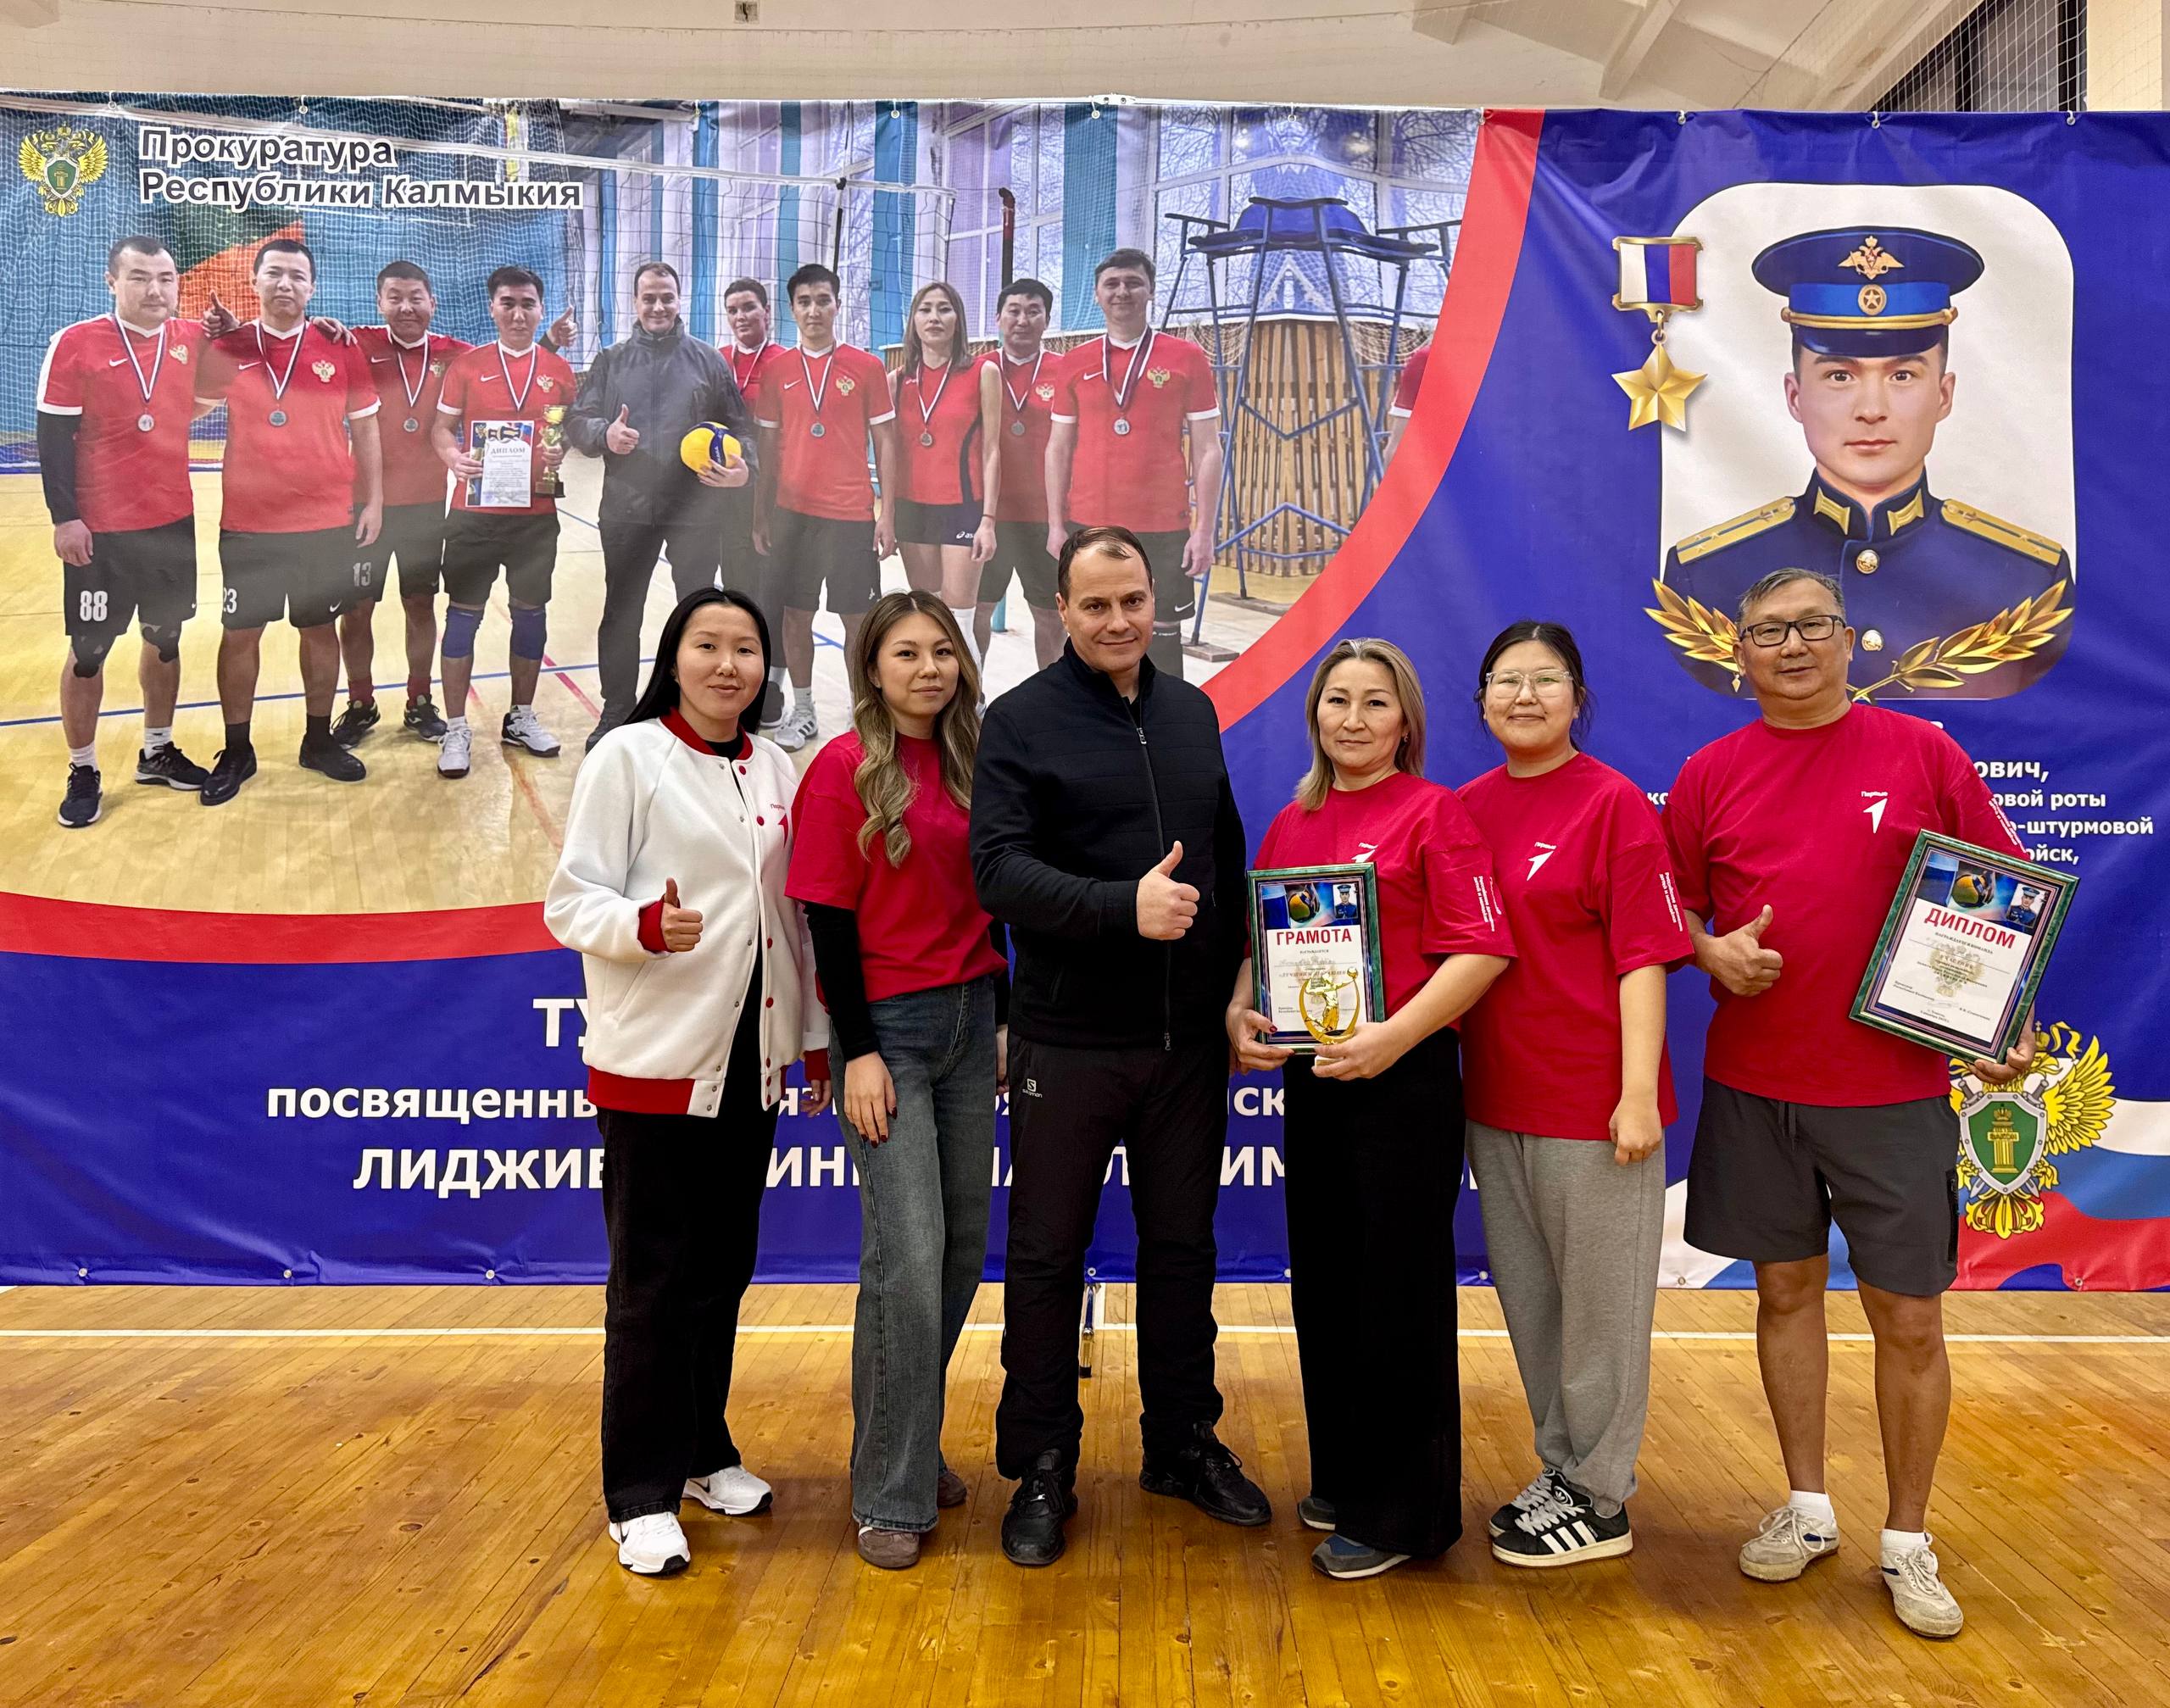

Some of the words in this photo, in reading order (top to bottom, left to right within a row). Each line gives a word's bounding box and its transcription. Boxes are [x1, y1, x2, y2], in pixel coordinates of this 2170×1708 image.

[141, 128, 396, 171] Прокуратура
[141, 170, 373, 211] Республики
[383, 176, 582, 209] Калмыкия
[490, 447, 526, 455] ДИПЛОМ
[353, 562, 372, 587] 13
[80, 590, 108, 622] 88
[2050, 793, 2106, 811] роты
[2009, 816, 2154, 838] -штурмовой
[1277, 928, 1352, 946] ГРАМОТА
[1924, 907, 2017, 949] ДИПЛОМ
[267, 1088, 598, 1125] посвященны
